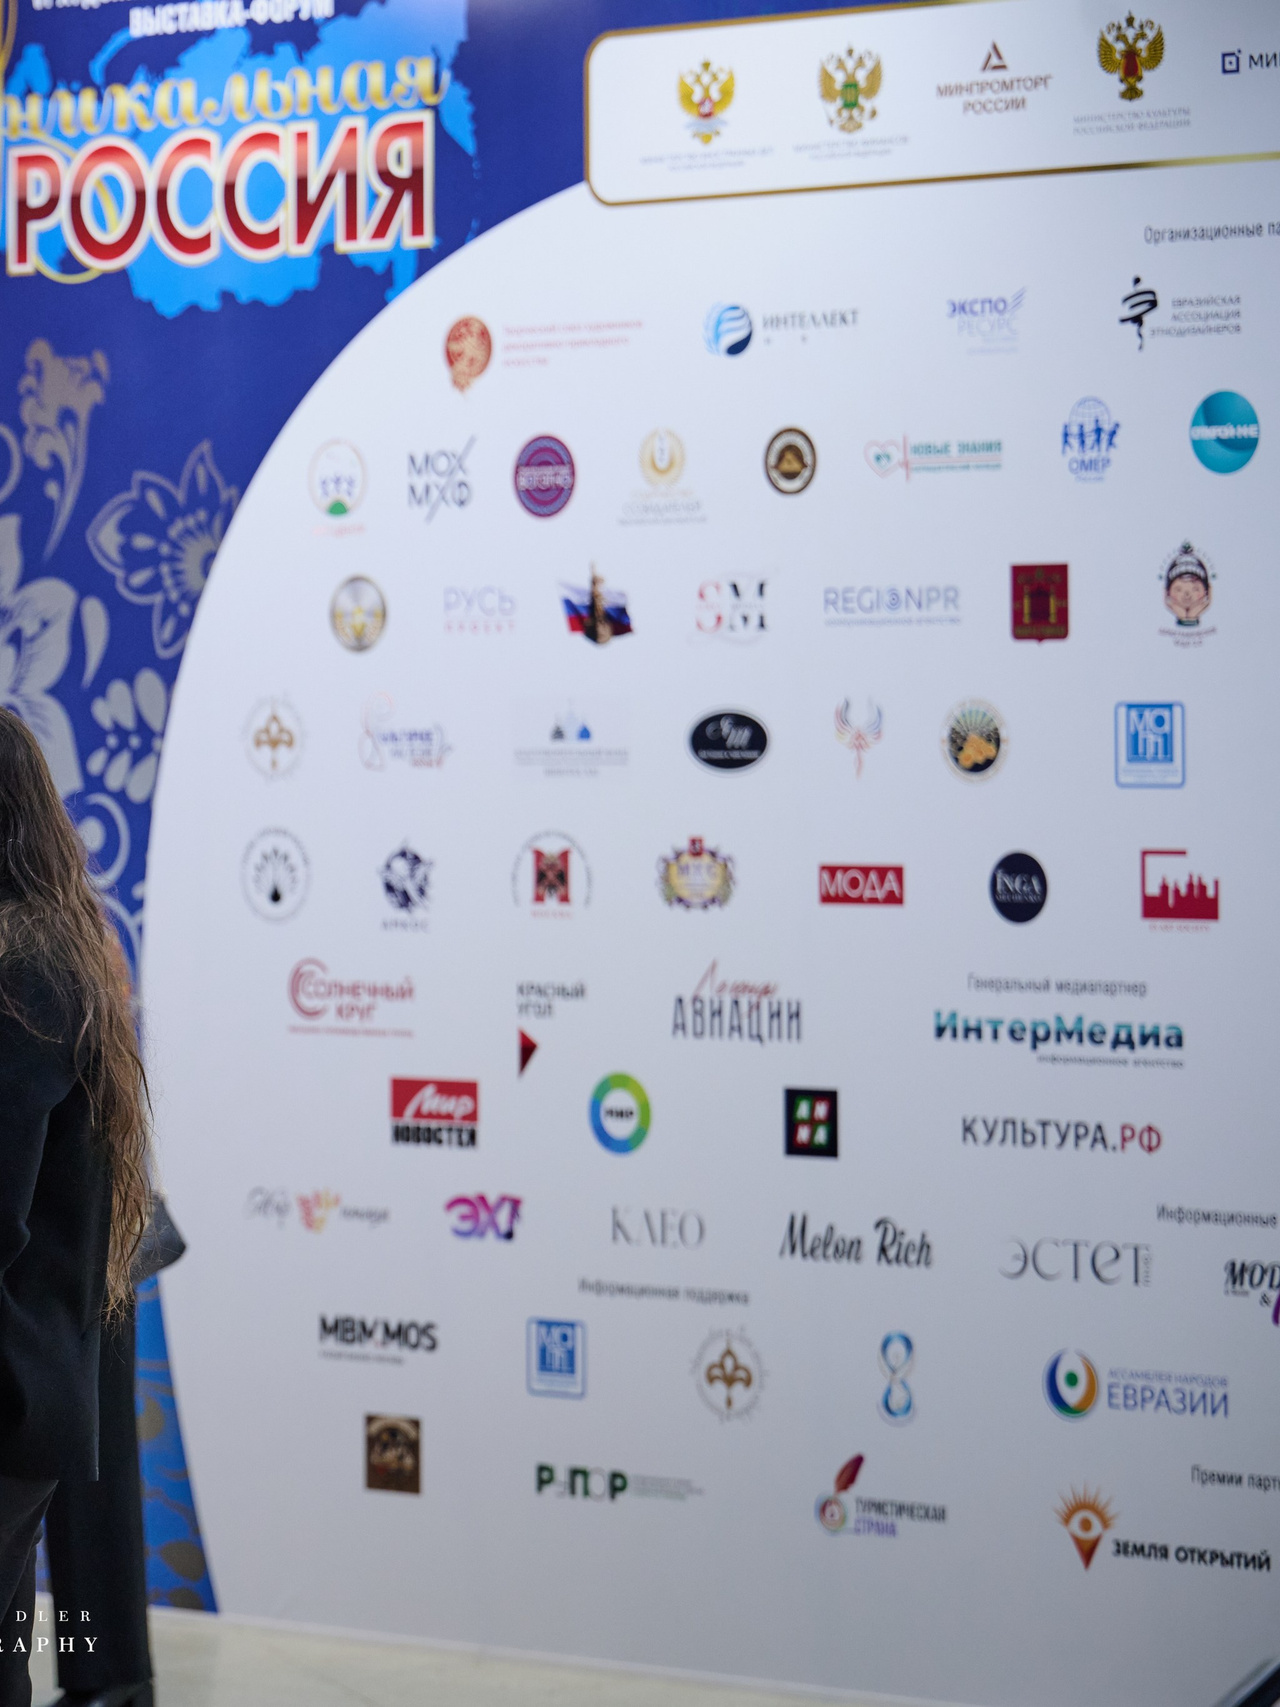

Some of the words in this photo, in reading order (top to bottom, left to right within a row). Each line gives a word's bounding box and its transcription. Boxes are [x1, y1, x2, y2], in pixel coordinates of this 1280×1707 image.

[1249, 52, 1280, 69] МИ
[936, 75, 1052, 98] МИНПРОМТОРГ
[962, 97, 1027, 114] РОССИИ
[6, 109, 436, 277] РОССИЯ
[1144, 223, 1262, 246] Организационные
[762, 308, 859, 331] ИНТЕЛЛЕКТ
[946, 297, 1009, 318] ЭКСПО
[443, 586, 518, 617] РУСЬ
[821, 868, 903, 902] МОДА
[968, 971, 1051, 995] Генеральный
[672, 994, 803, 1046] АВИАЦИИ
[933, 1010, 1184, 1052] ИнтерМедиа
[962, 1116, 1161, 1154] КУЛЬТУРА.РФ
[1156, 1203, 1278, 1230] Информационные
[779, 1211, 862, 1264] Melon
[873, 1216, 932, 1269] Rich
[1107, 1383, 1229, 1418] ЕВРАЗИИ
[1190, 1463, 1243, 1488] Премии
[855, 1497, 947, 1523] ТУРИСТИЧЕСКАЯ
[854, 1516, 898, 1538] СТРАНА
[1111, 1538, 1170, 1562] ЗЕМЛЯ
[1174, 1546, 1272, 1572] ОТКРЫТИЙ
